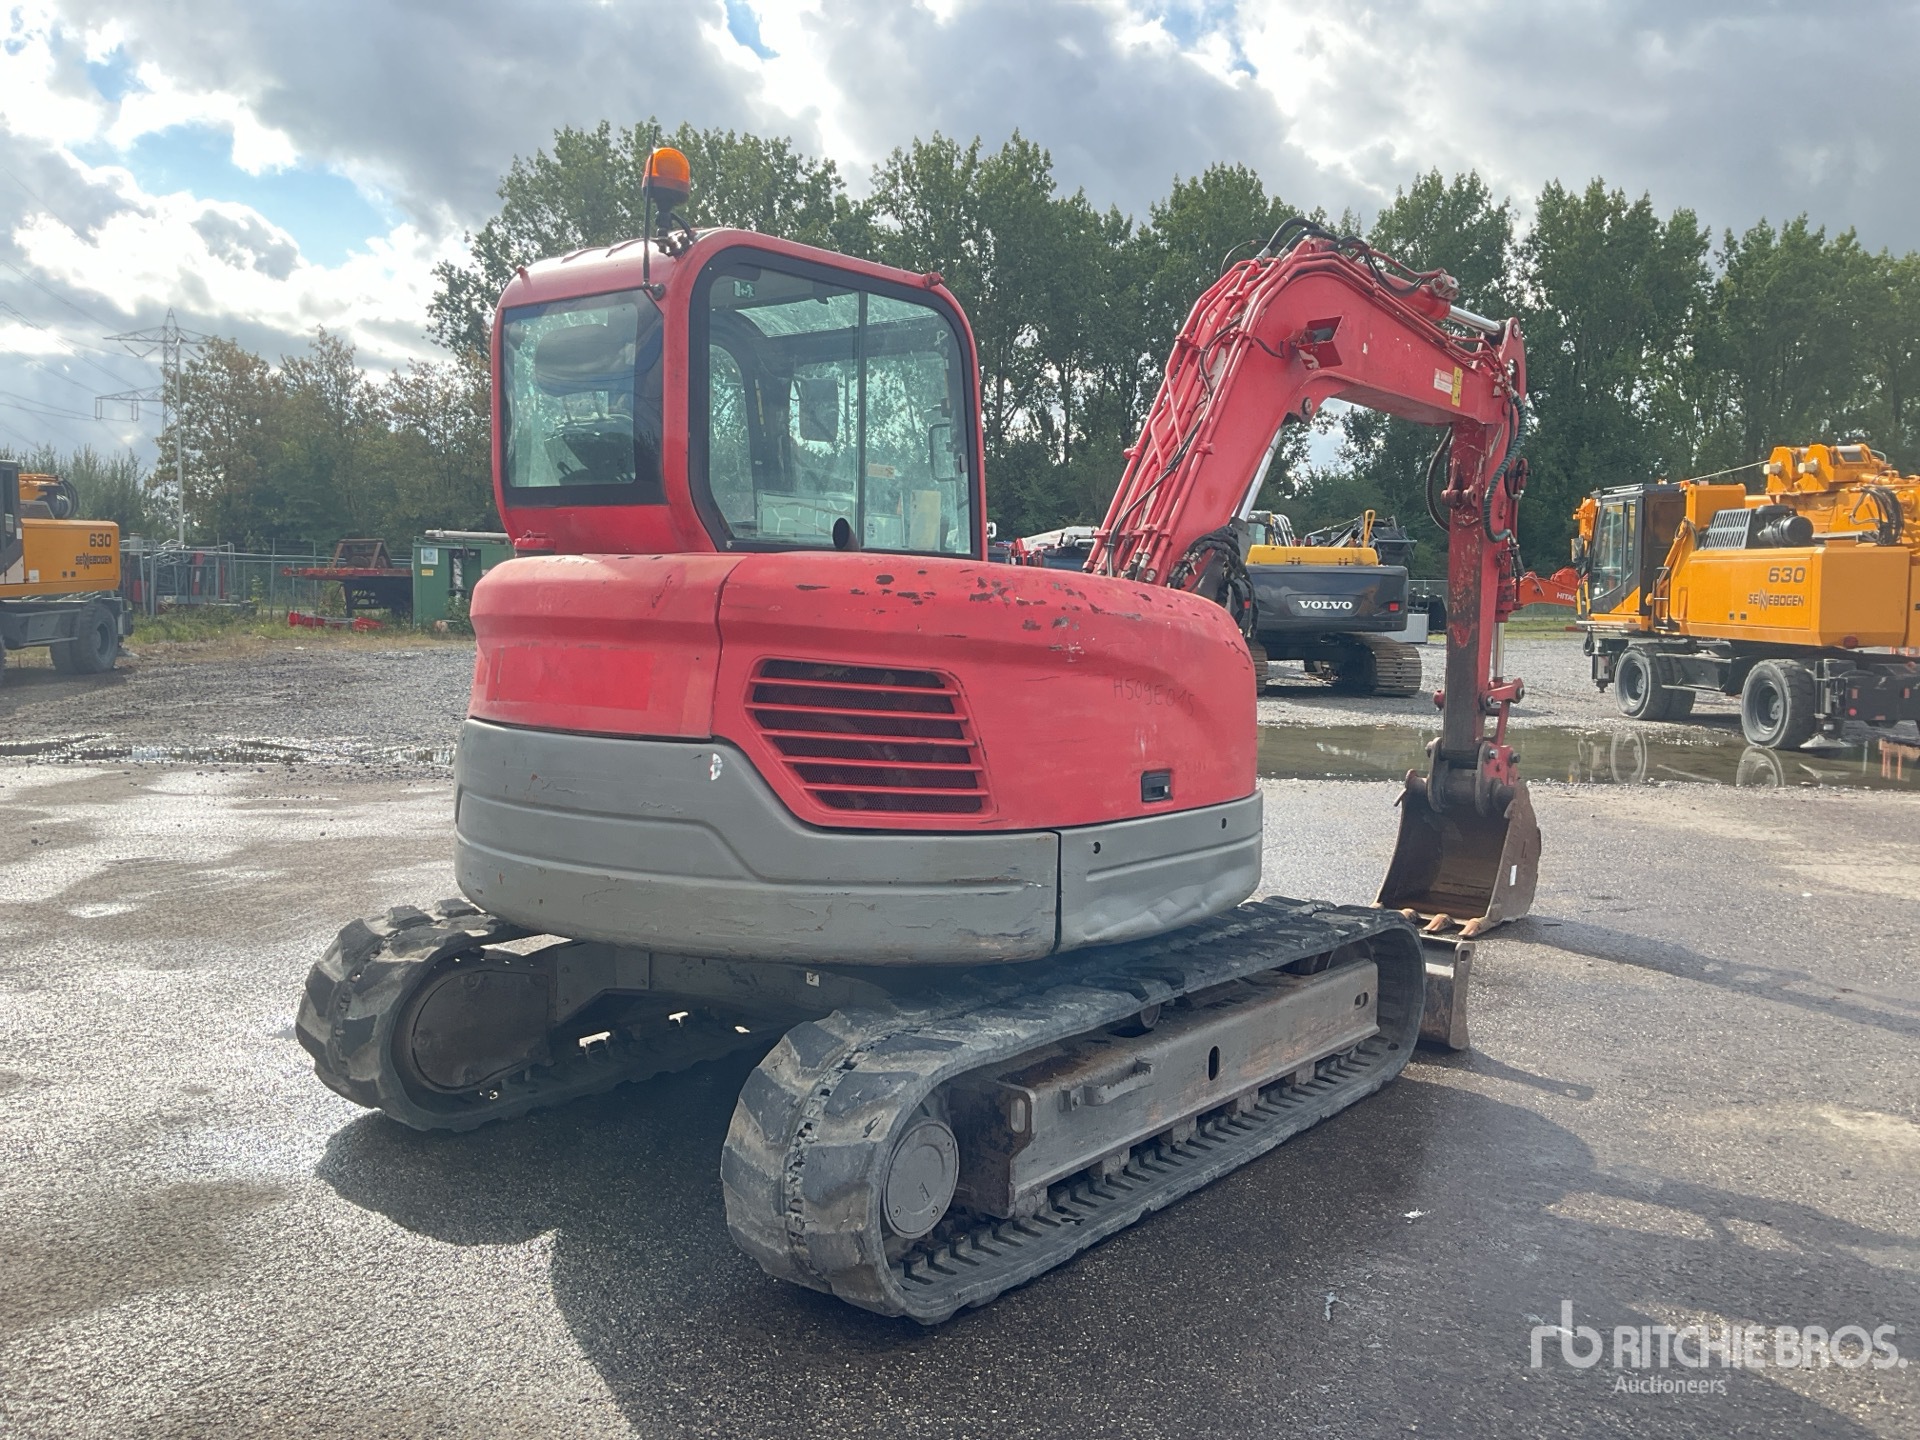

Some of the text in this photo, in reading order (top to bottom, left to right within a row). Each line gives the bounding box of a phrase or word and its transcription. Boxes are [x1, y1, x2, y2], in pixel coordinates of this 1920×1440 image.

[90, 533, 112, 547] 630
[1768, 567, 1806, 583] 630
[1297, 600, 1353, 610] VOLVO
